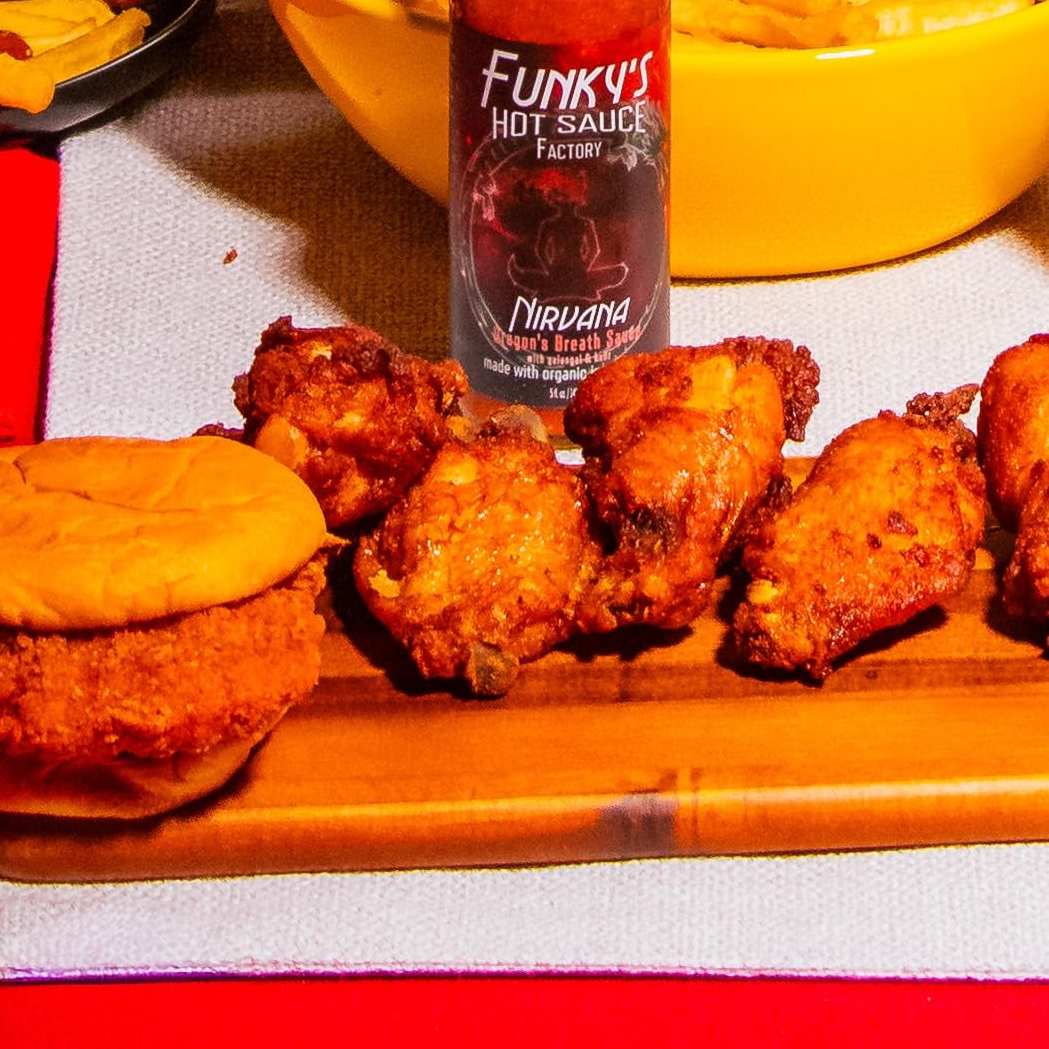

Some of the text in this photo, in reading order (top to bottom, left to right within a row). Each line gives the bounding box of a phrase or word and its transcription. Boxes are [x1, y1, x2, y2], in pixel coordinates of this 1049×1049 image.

[491, 100, 648, 140] HOT SAUCE
[554, 332, 602, 353] Breath
[606, 324, 642, 349] Sauce
[483, 356, 511, 376] made
[513, 364, 540, 380] with
[541, 367, 588, 384] organic
